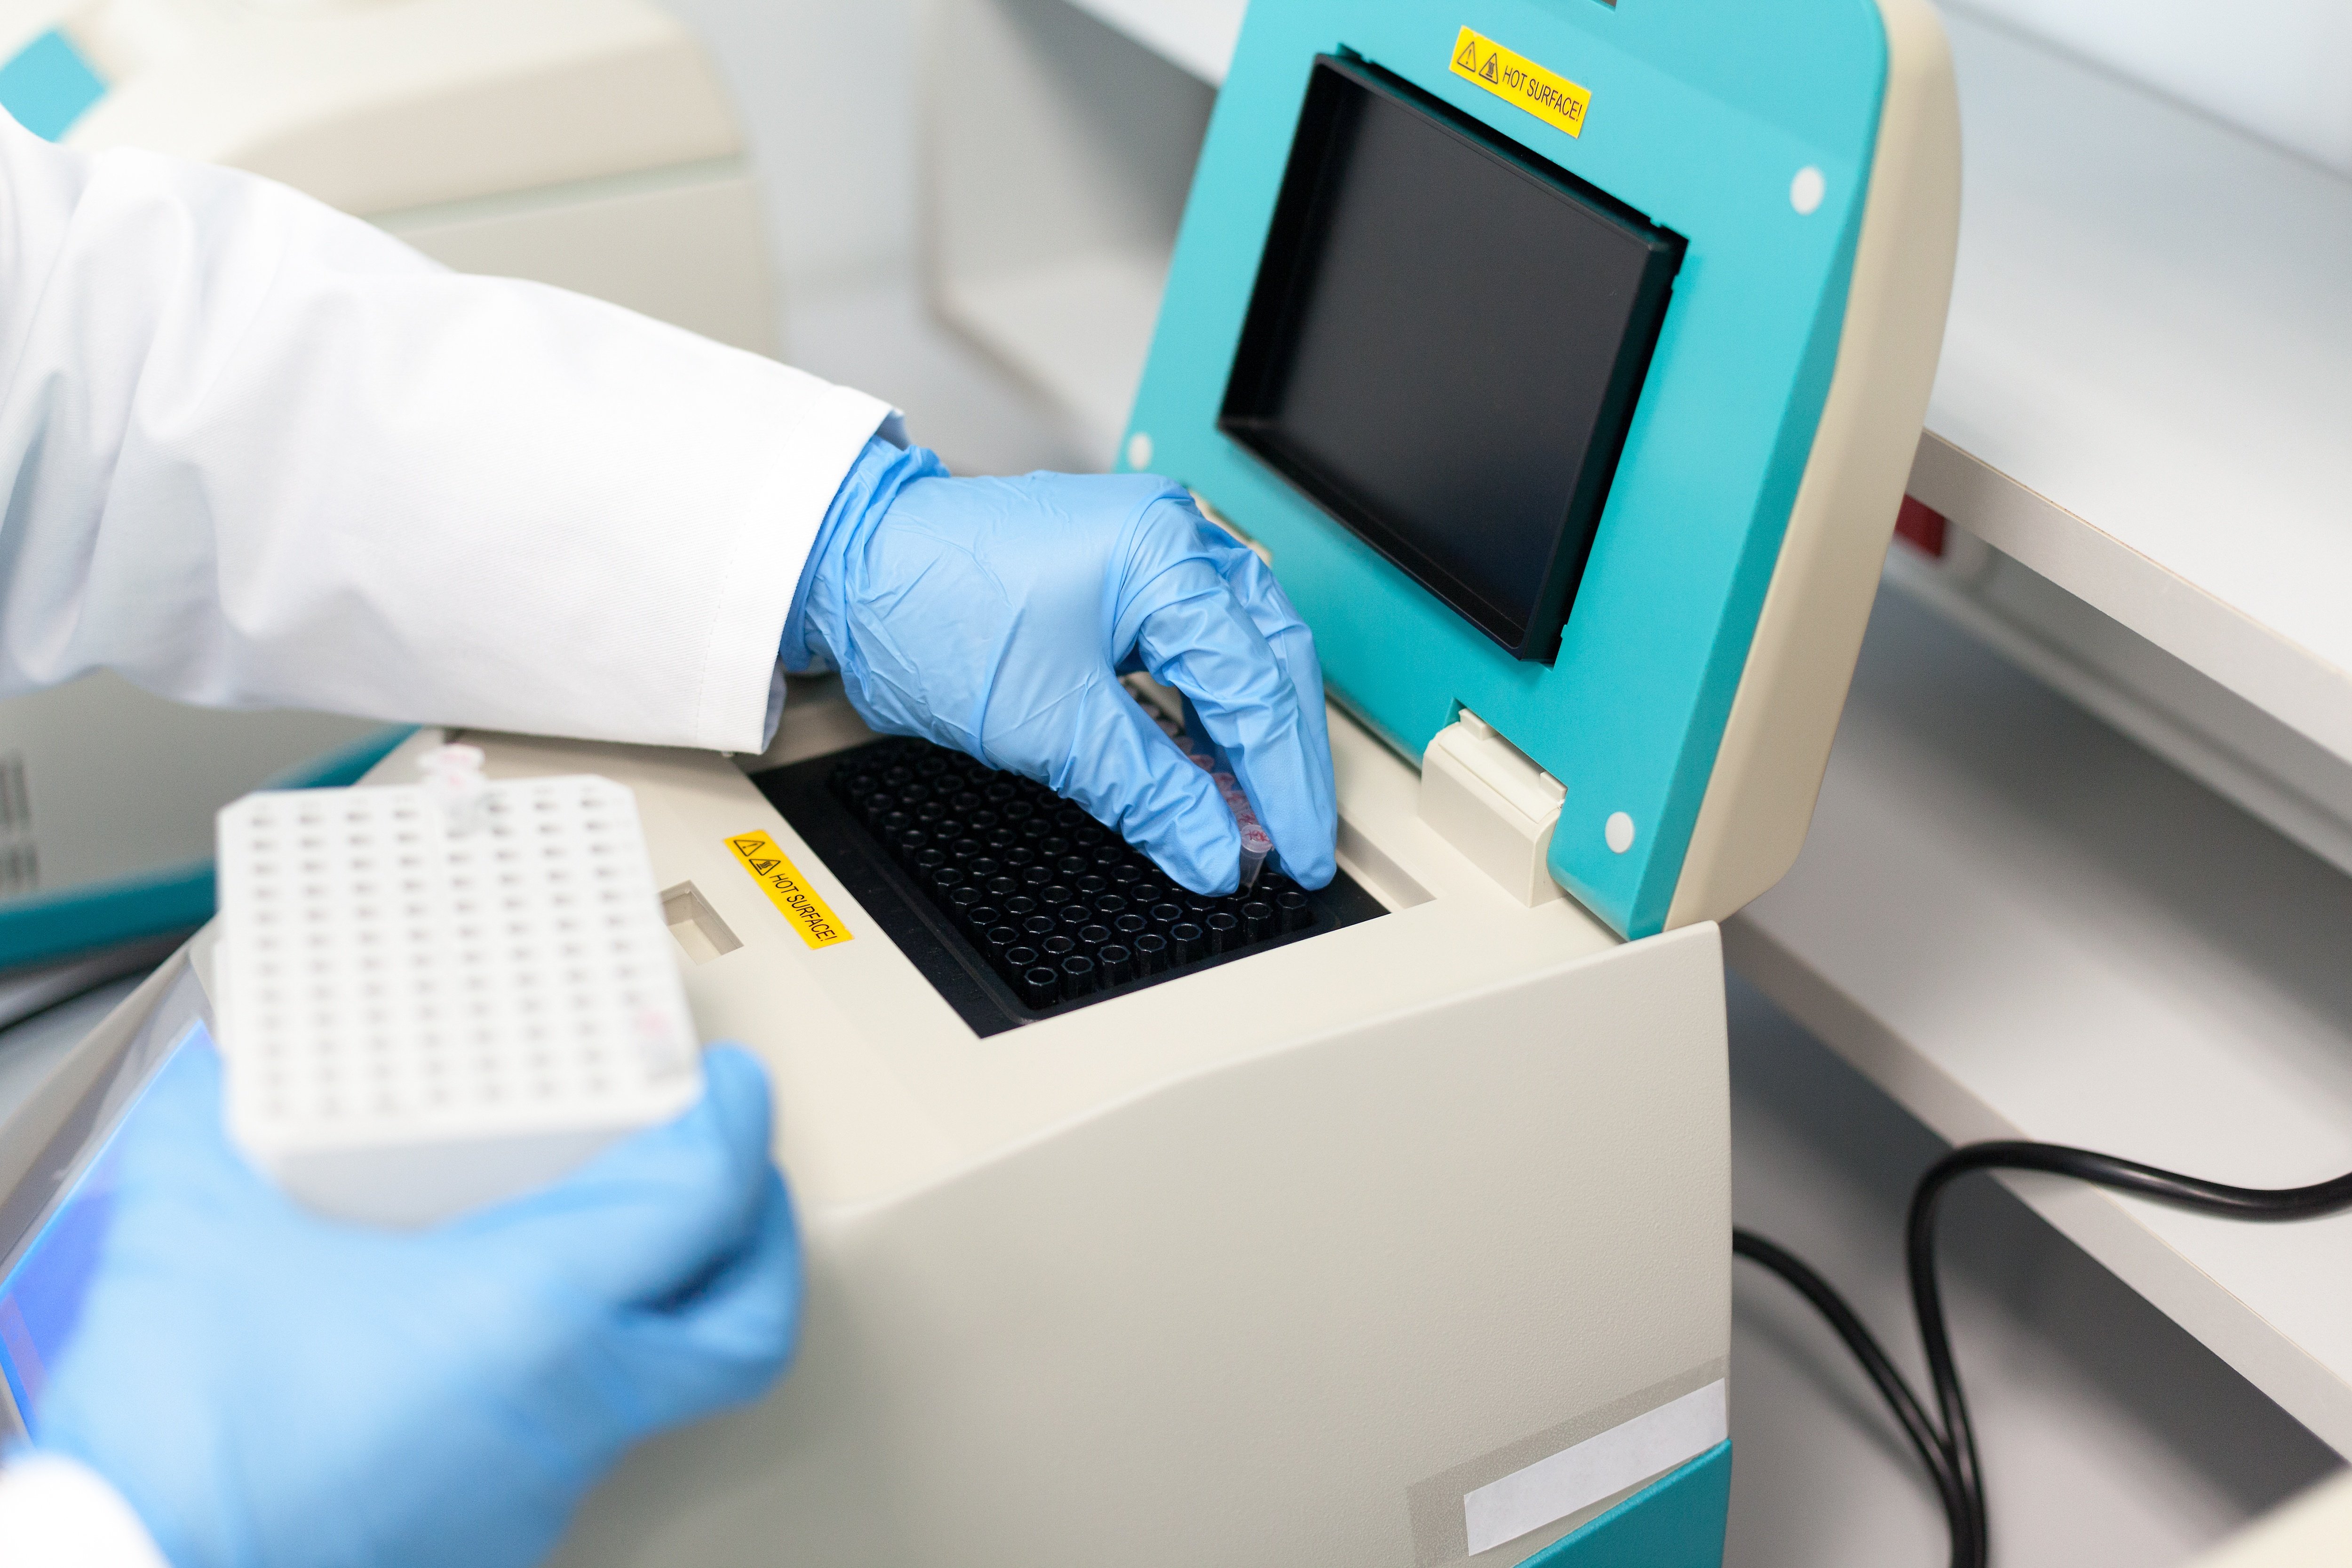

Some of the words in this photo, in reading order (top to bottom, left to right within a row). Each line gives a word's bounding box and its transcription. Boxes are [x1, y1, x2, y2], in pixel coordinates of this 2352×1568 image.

[1502, 65, 1527, 91] HOT
[1527, 79, 1582, 121] SURFACE!
[769, 873, 799, 893] HOT
[787, 894, 837, 941] SURFACE!
